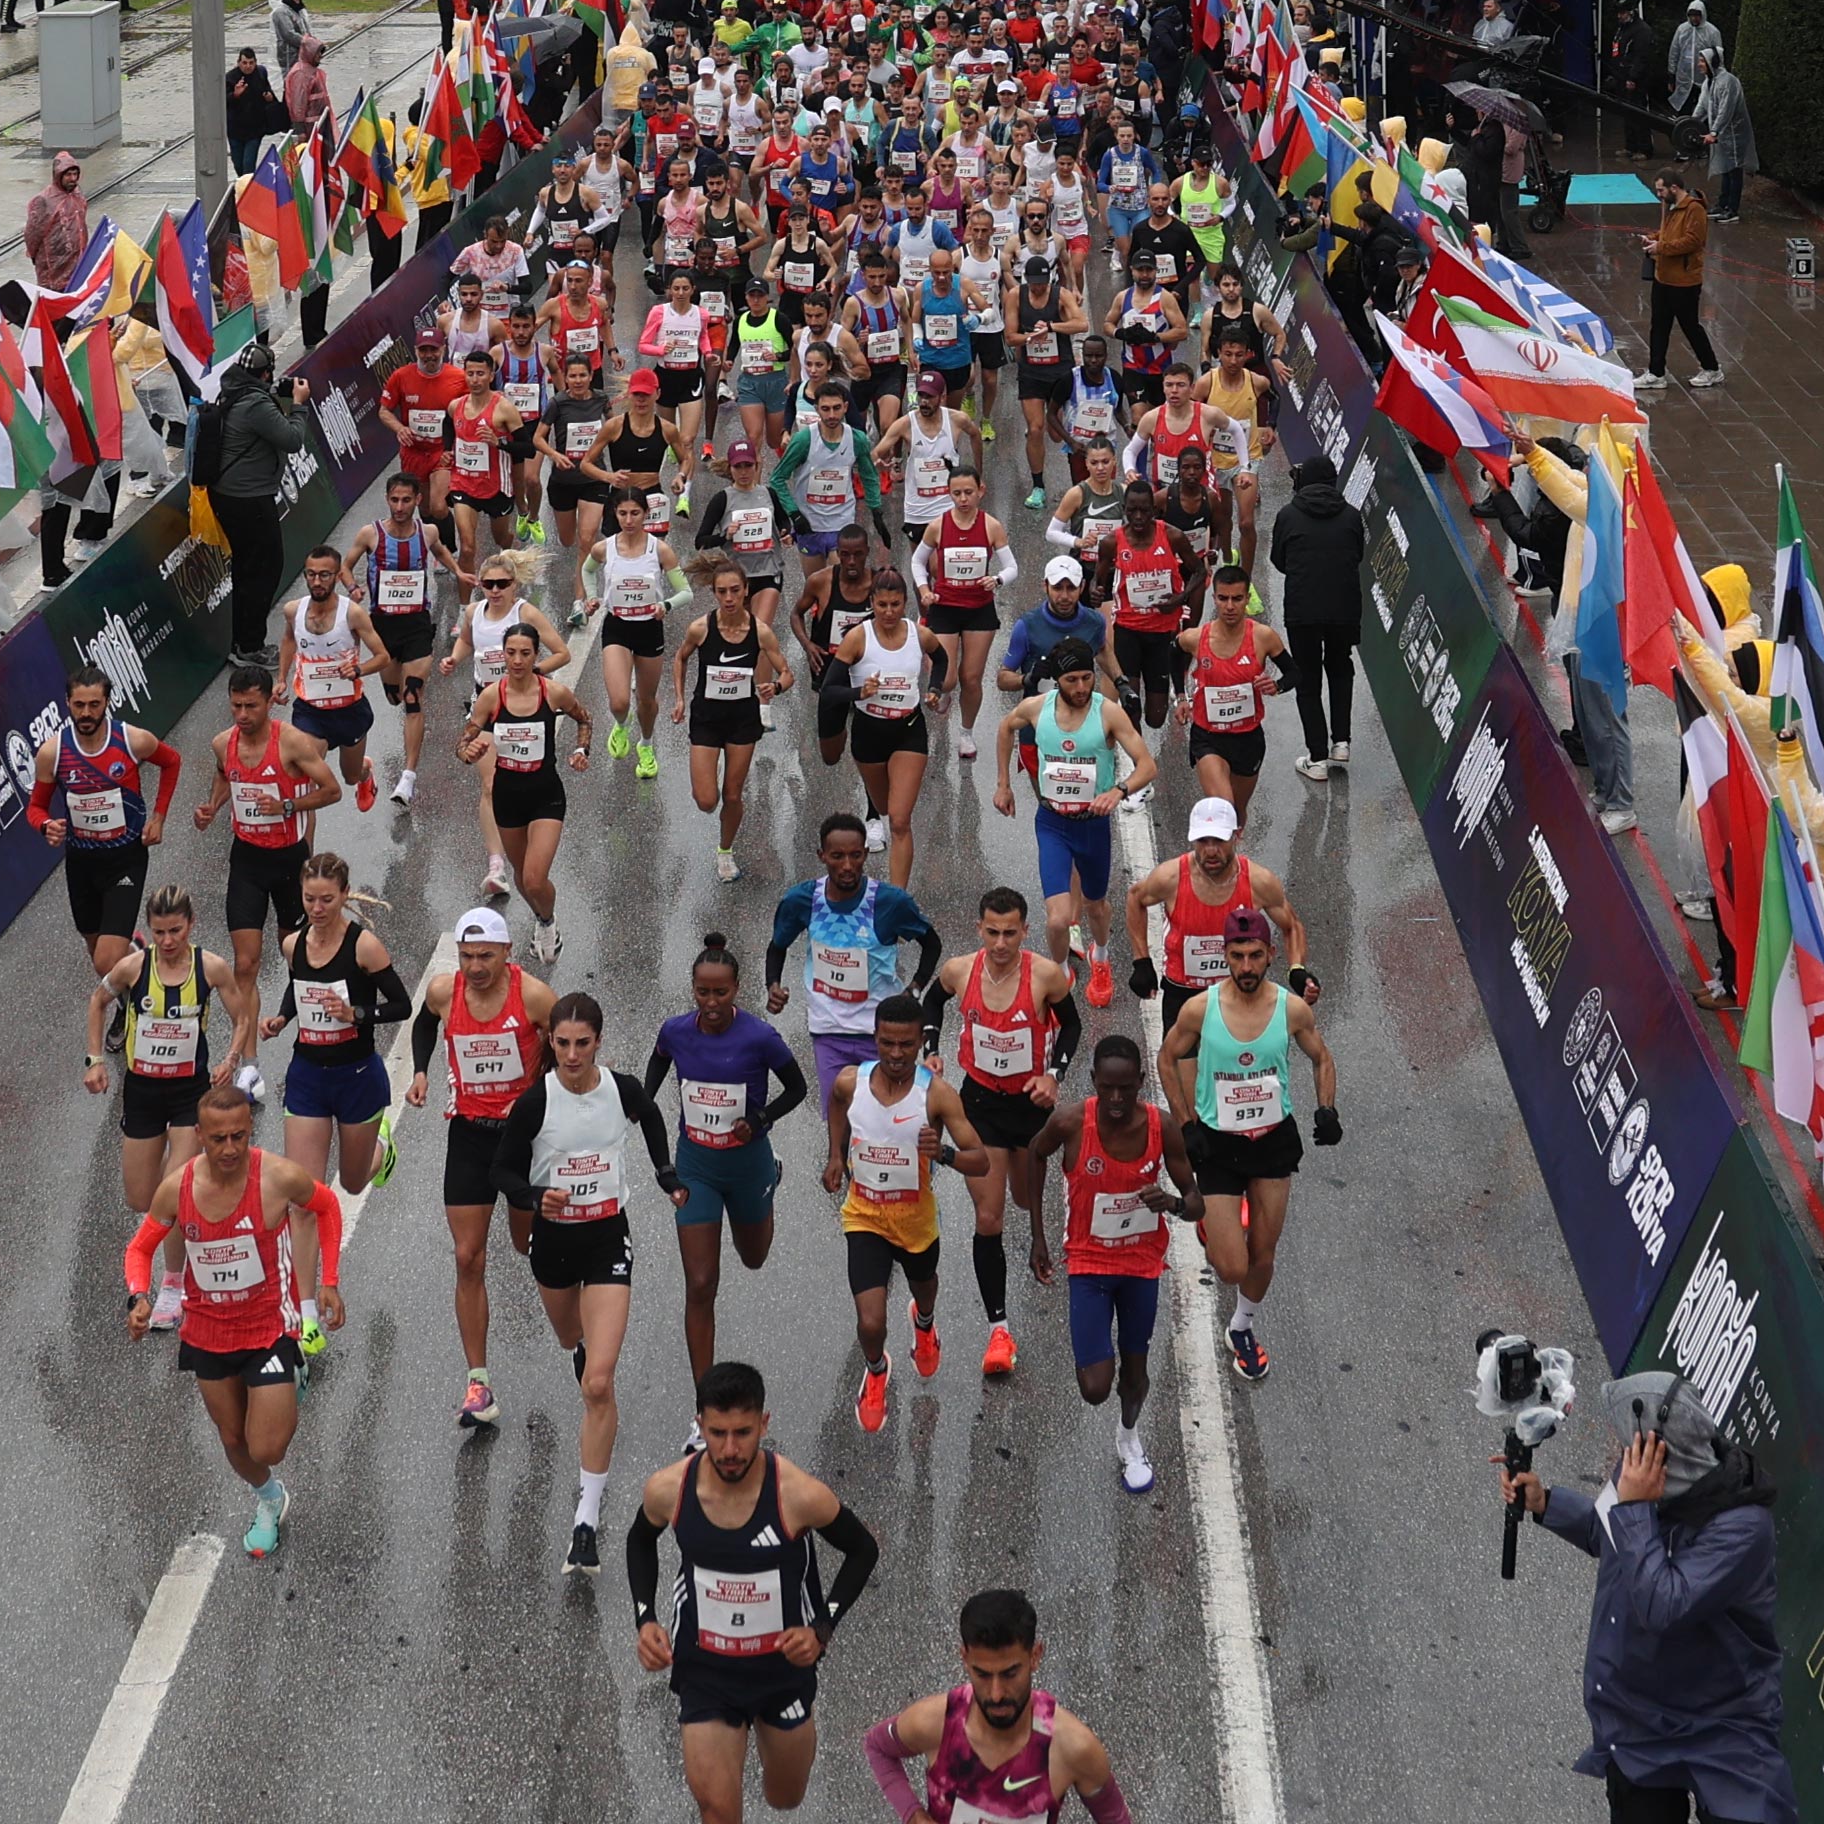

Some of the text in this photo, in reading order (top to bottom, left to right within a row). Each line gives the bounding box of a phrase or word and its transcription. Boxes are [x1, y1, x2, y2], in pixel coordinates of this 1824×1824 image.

[1798, 260, 1807, 273] 6
[956, 566, 973, 575] 107
[387, 589, 414, 599] 1020
[623, 592, 644, 602] 745
[1147, 594, 1154, 602] 5
[126, 601, 150, 627] KONYA
[139, 620, 175, 660] MARATONU
[324, 683, 333, 692] 7
[717, 686, 739, 695] 108
[1218, 706, 1243, 717] 602
[28, 700, 63, 748] SPOR
[510, 744, 529, 756] 178
[1055, 785, 1081, 795] 936
[244, 806, 262, 817] 60
[83, 814, 109, 824] 758
[829, 970, 845, 983] 10
[150, 1045, 178, 1057] 106
[475, 1061, 503, 1075] 647
[993, 1057, 1009, 1069] 15
[699, 1087, 726, 1096] KONYA
[691, 1096, 736, 1106] MARATONU
[703, 1113, 720, 1126] 111
[1235, 1107, 1265, 1121] 937
[869, 1146, 898, 1155] KONYA
[570, 1155, 598, 1165] KONYA
[860, 1154, 909, 1165] MARATONU
[560, 1163, 609, 1175] MARATONU
[878, 1171, 889, 1183] 9
[1640, 1143, 1676, 1218] SPOR
[570, 1181, 599, 1196] 105
[1624, 1172, 1668, 1267] KONYA
[205, 1244, 234, 1256] KONYA
[199, 1252, 247, 1263] MARATONU
[212, 1269, 239, 1283] 174
[1748, 1365, 1782, 1441] KONYA
[1737, 1391, 1761, 1447] YARI
[719, 1581, 755, 1591] KONYA
[708, 1592, 767, 1603] MARATONU
[730, 1613, 745, 1627] 8
